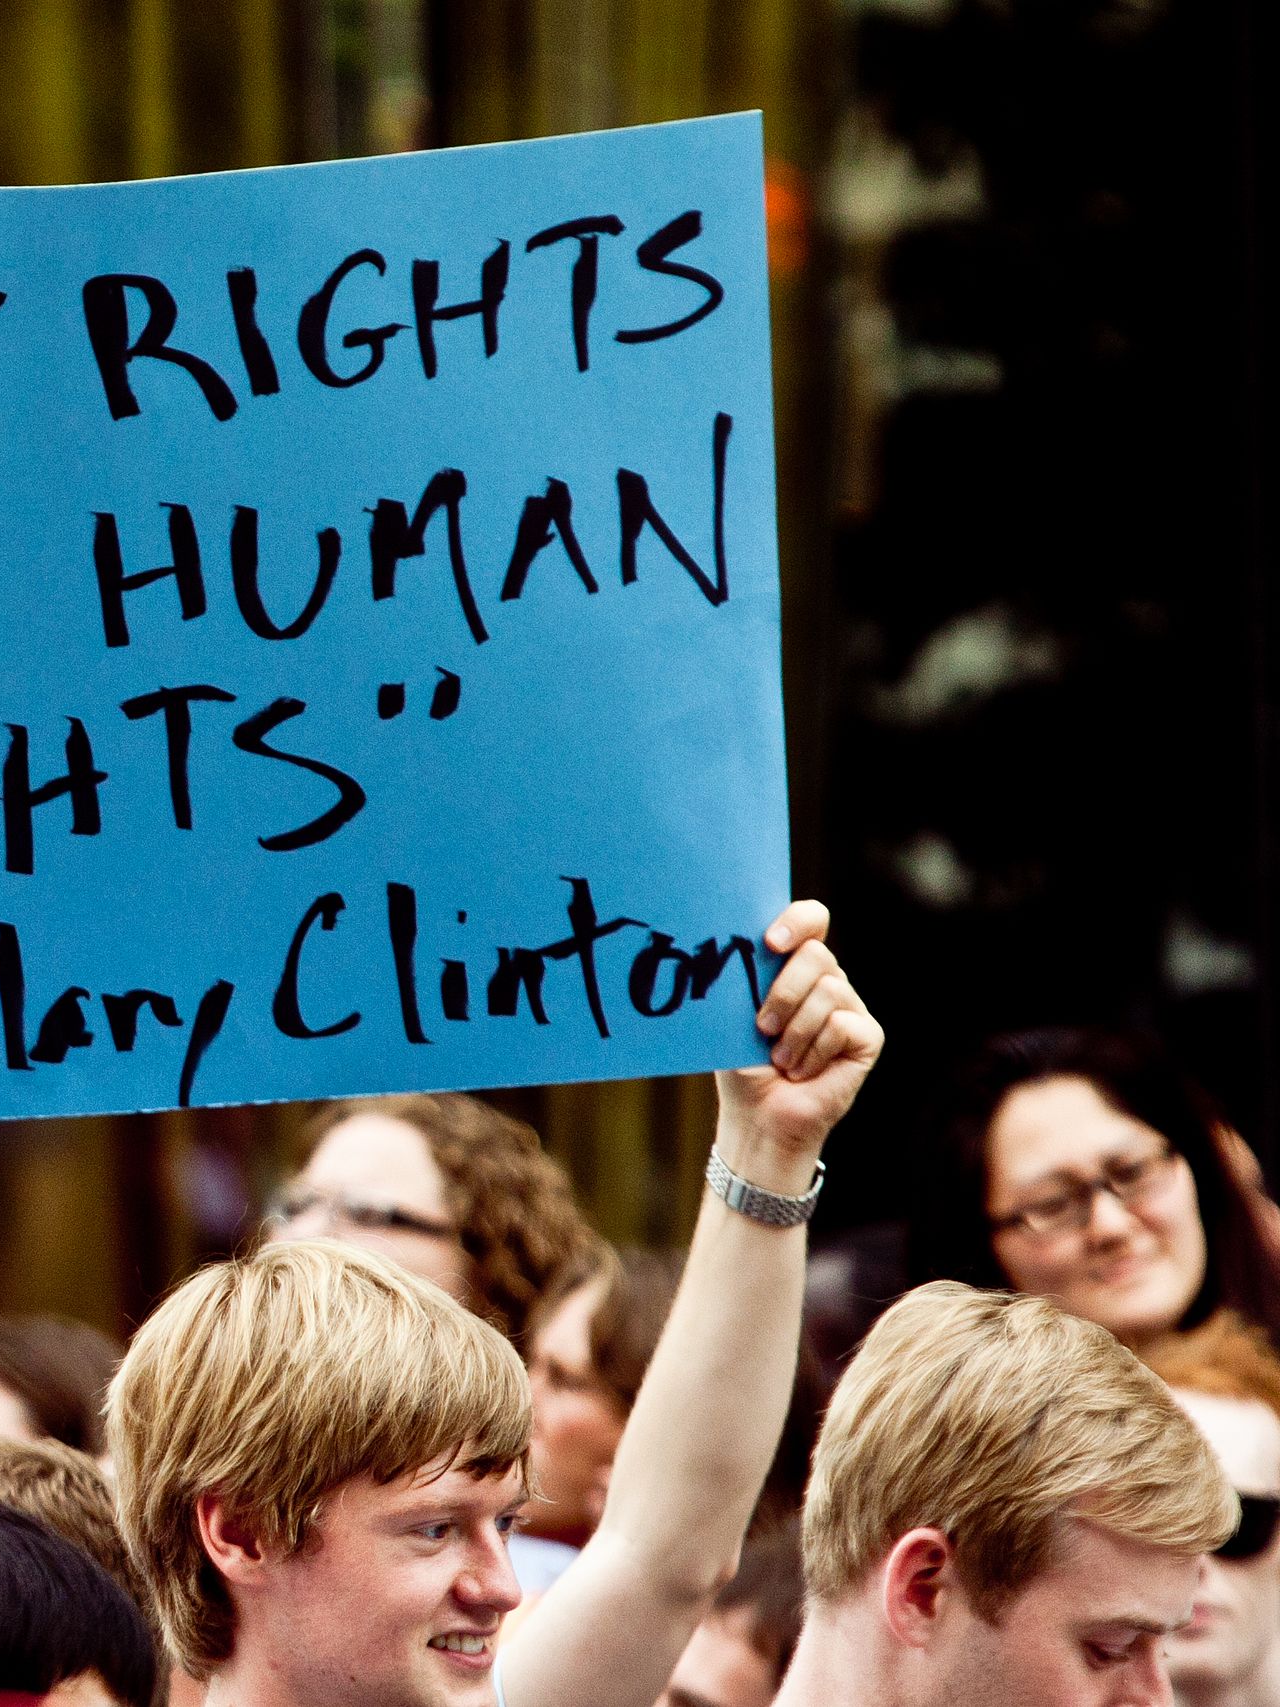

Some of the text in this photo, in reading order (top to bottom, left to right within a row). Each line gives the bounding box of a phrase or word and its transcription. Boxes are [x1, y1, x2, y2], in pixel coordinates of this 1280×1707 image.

[81, 210, 724, 423] RIGHTS
[91, 412, 733, 649] HUMAN
[271, 875, 763, 1045] Clinton
